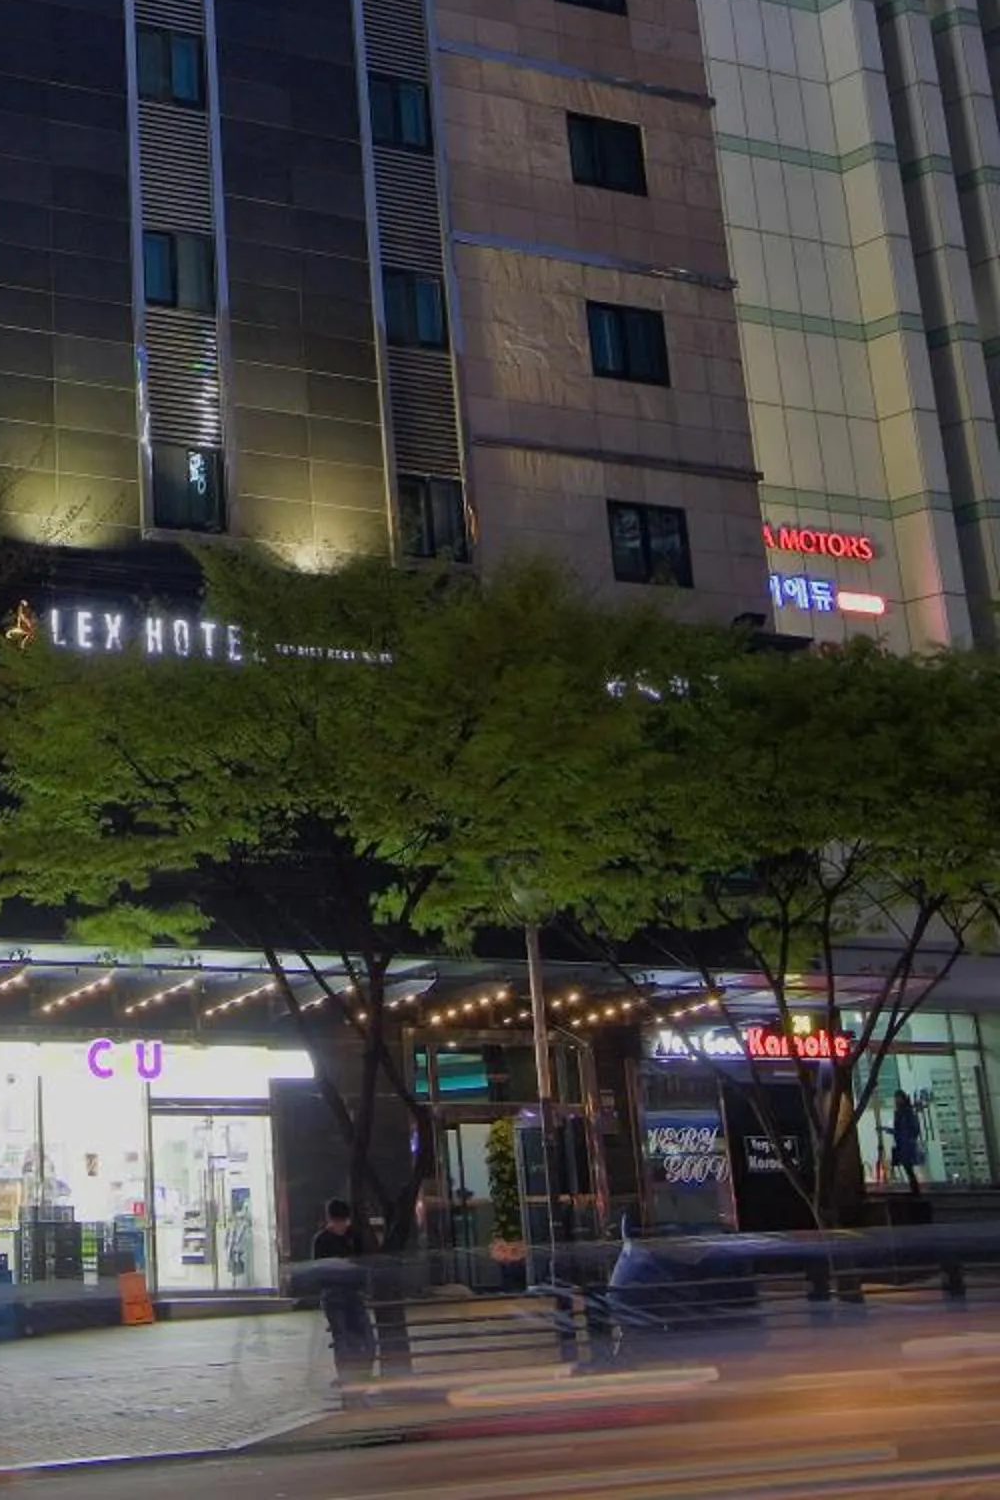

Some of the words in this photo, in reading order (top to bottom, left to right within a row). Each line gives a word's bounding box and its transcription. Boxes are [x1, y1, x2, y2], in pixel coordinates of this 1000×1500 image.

[780, 526, 874, 561] MOTORS
[51, 608, 123, 650] LEX
[87, 1039, 164, 1080] CU
